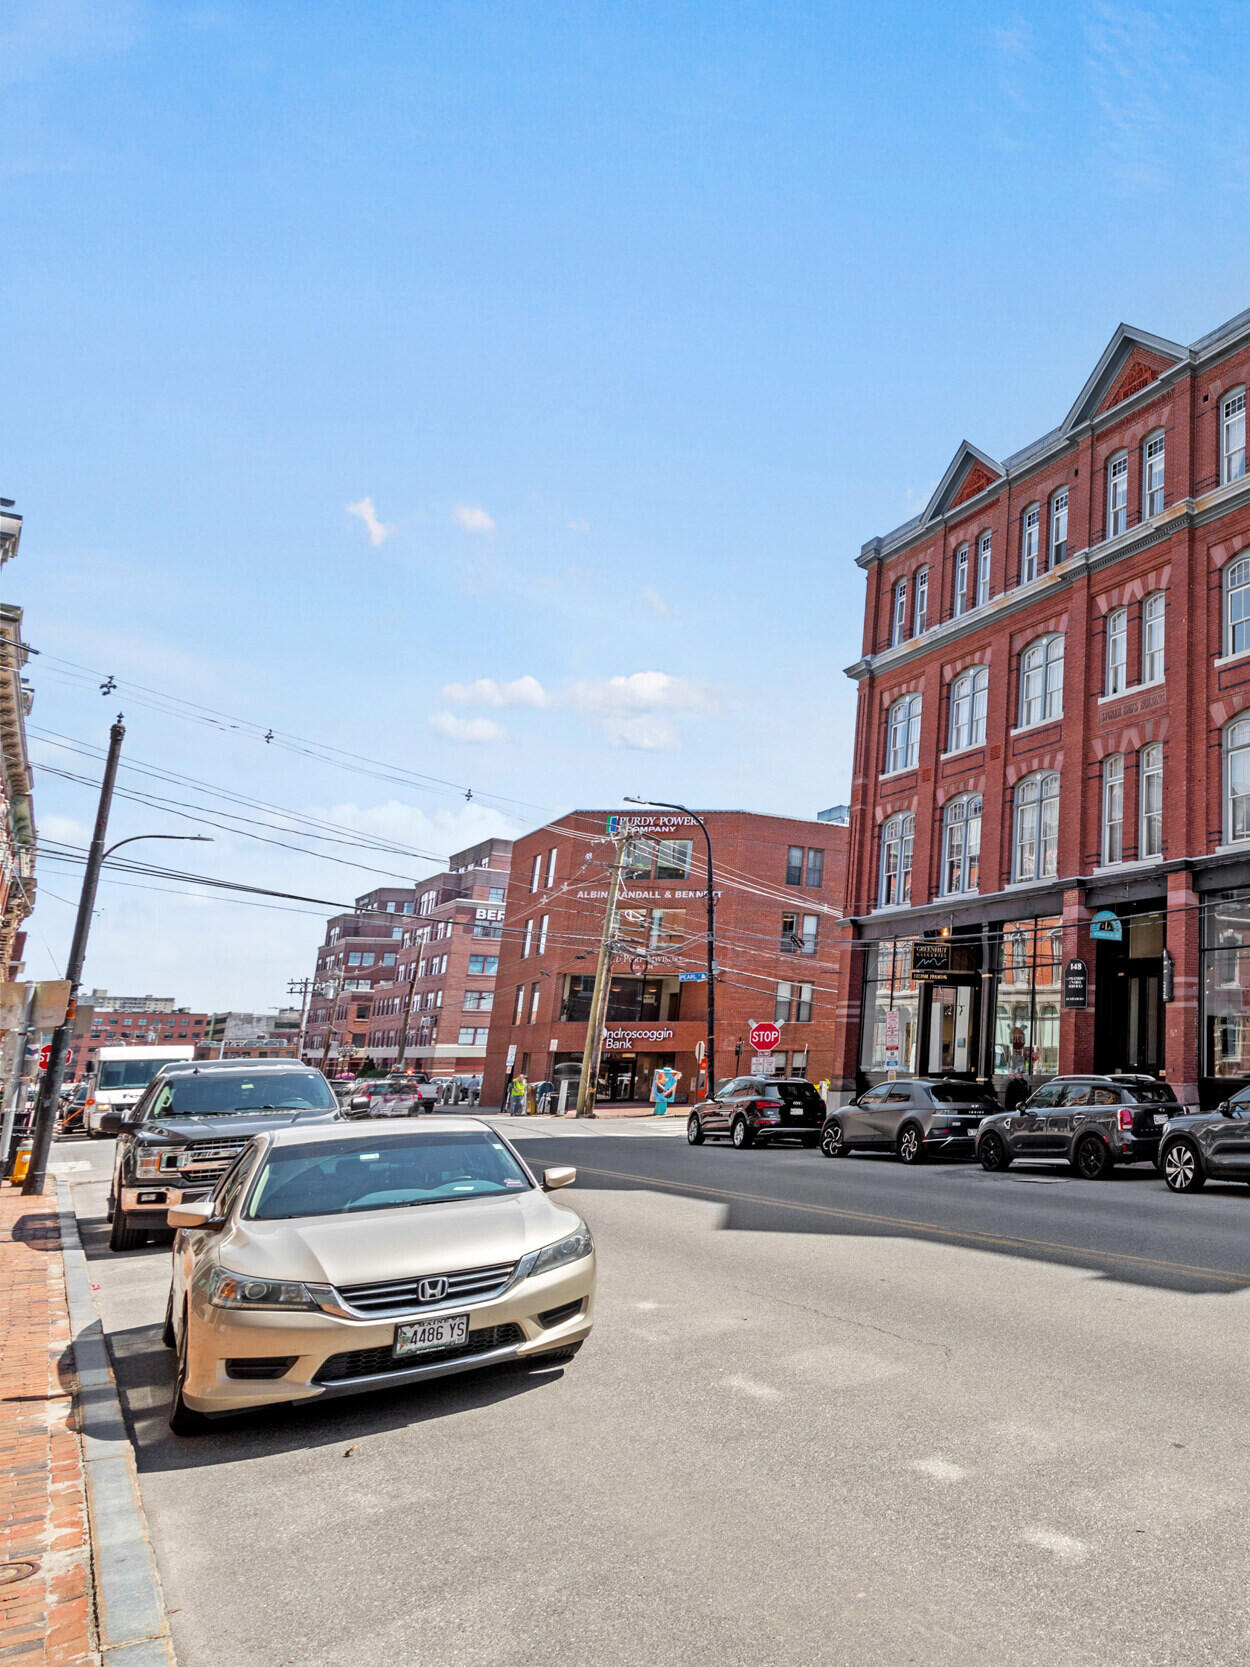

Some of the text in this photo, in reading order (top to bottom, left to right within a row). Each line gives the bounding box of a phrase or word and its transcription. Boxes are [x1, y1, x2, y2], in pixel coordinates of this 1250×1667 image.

[619, 816, 657, 826] PURDY
[577, 890, 608, 898] ALBIN
[1070, 963, 1083, 971] 148
[752, 1031, 778, 1042] STOP
[605, 1039, 632, 1049] Bank
[410, 1321, 465, 1345] 4486 YS
